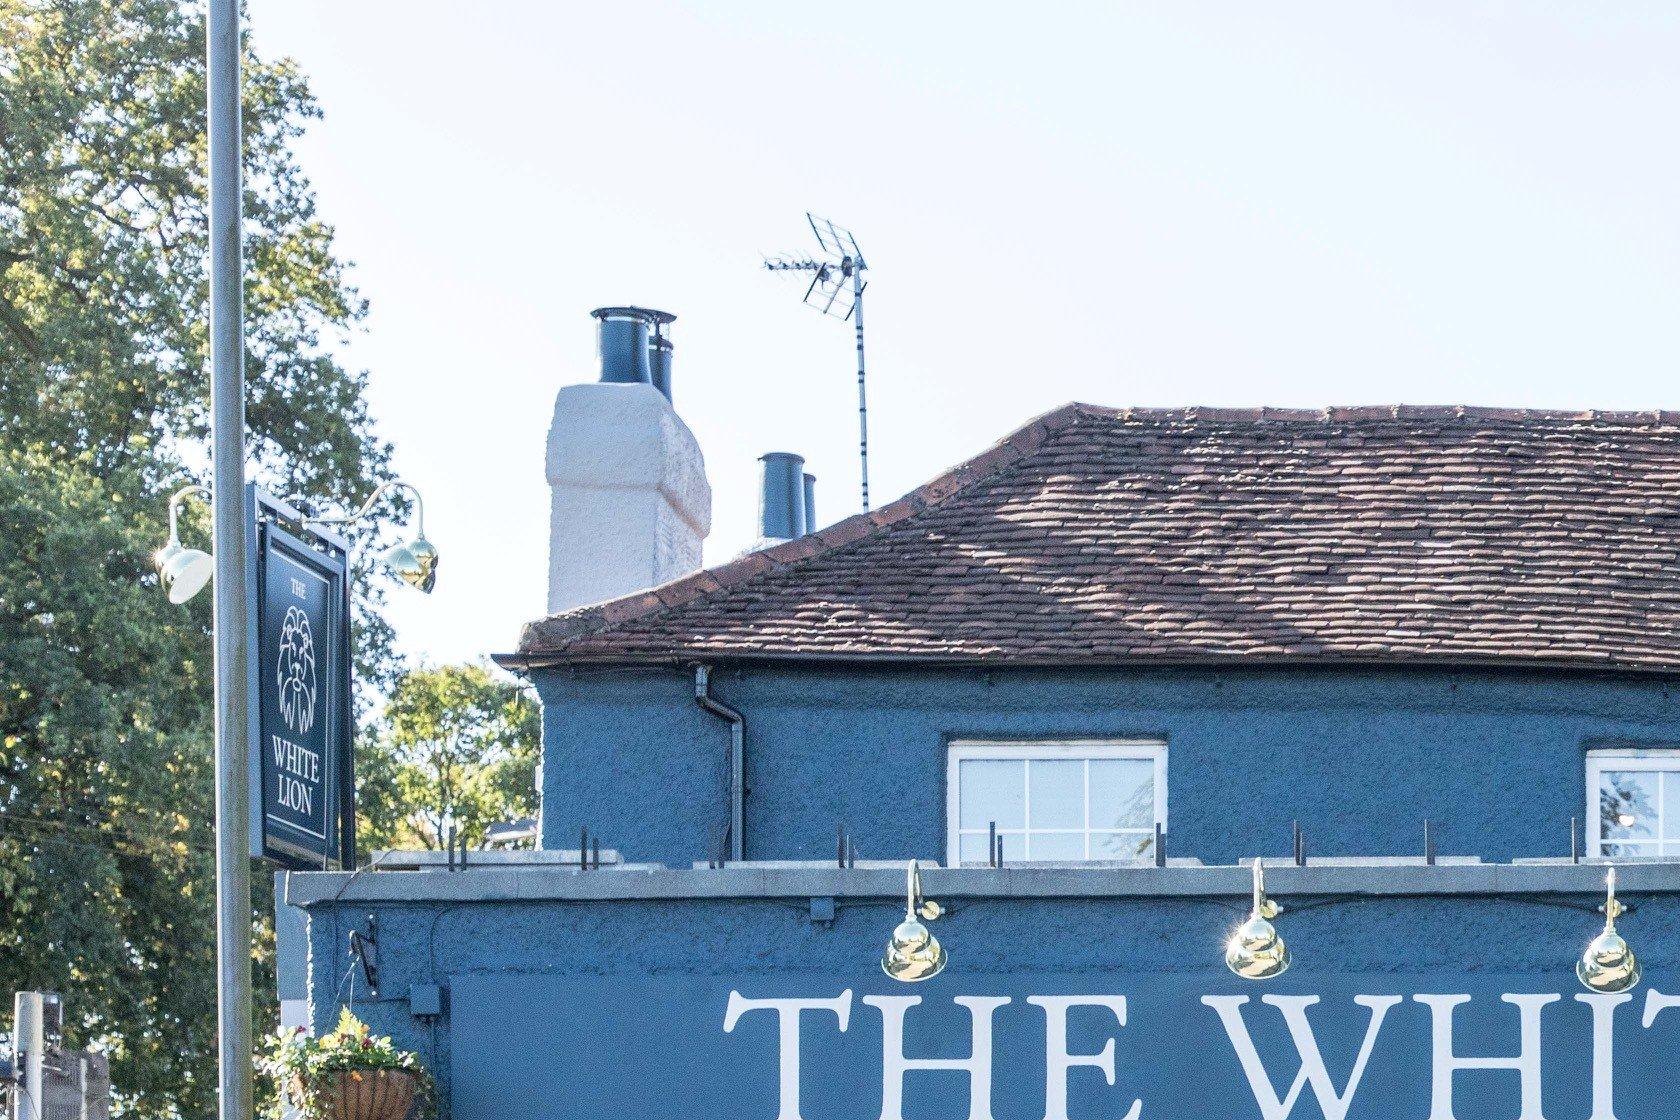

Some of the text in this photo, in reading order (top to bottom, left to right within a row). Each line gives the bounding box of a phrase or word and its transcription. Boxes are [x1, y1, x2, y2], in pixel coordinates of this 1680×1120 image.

[291, 578, 306, 600] THE
[272, 735, 319, 783] WHITE
[277, 774, 312, 816] LION
